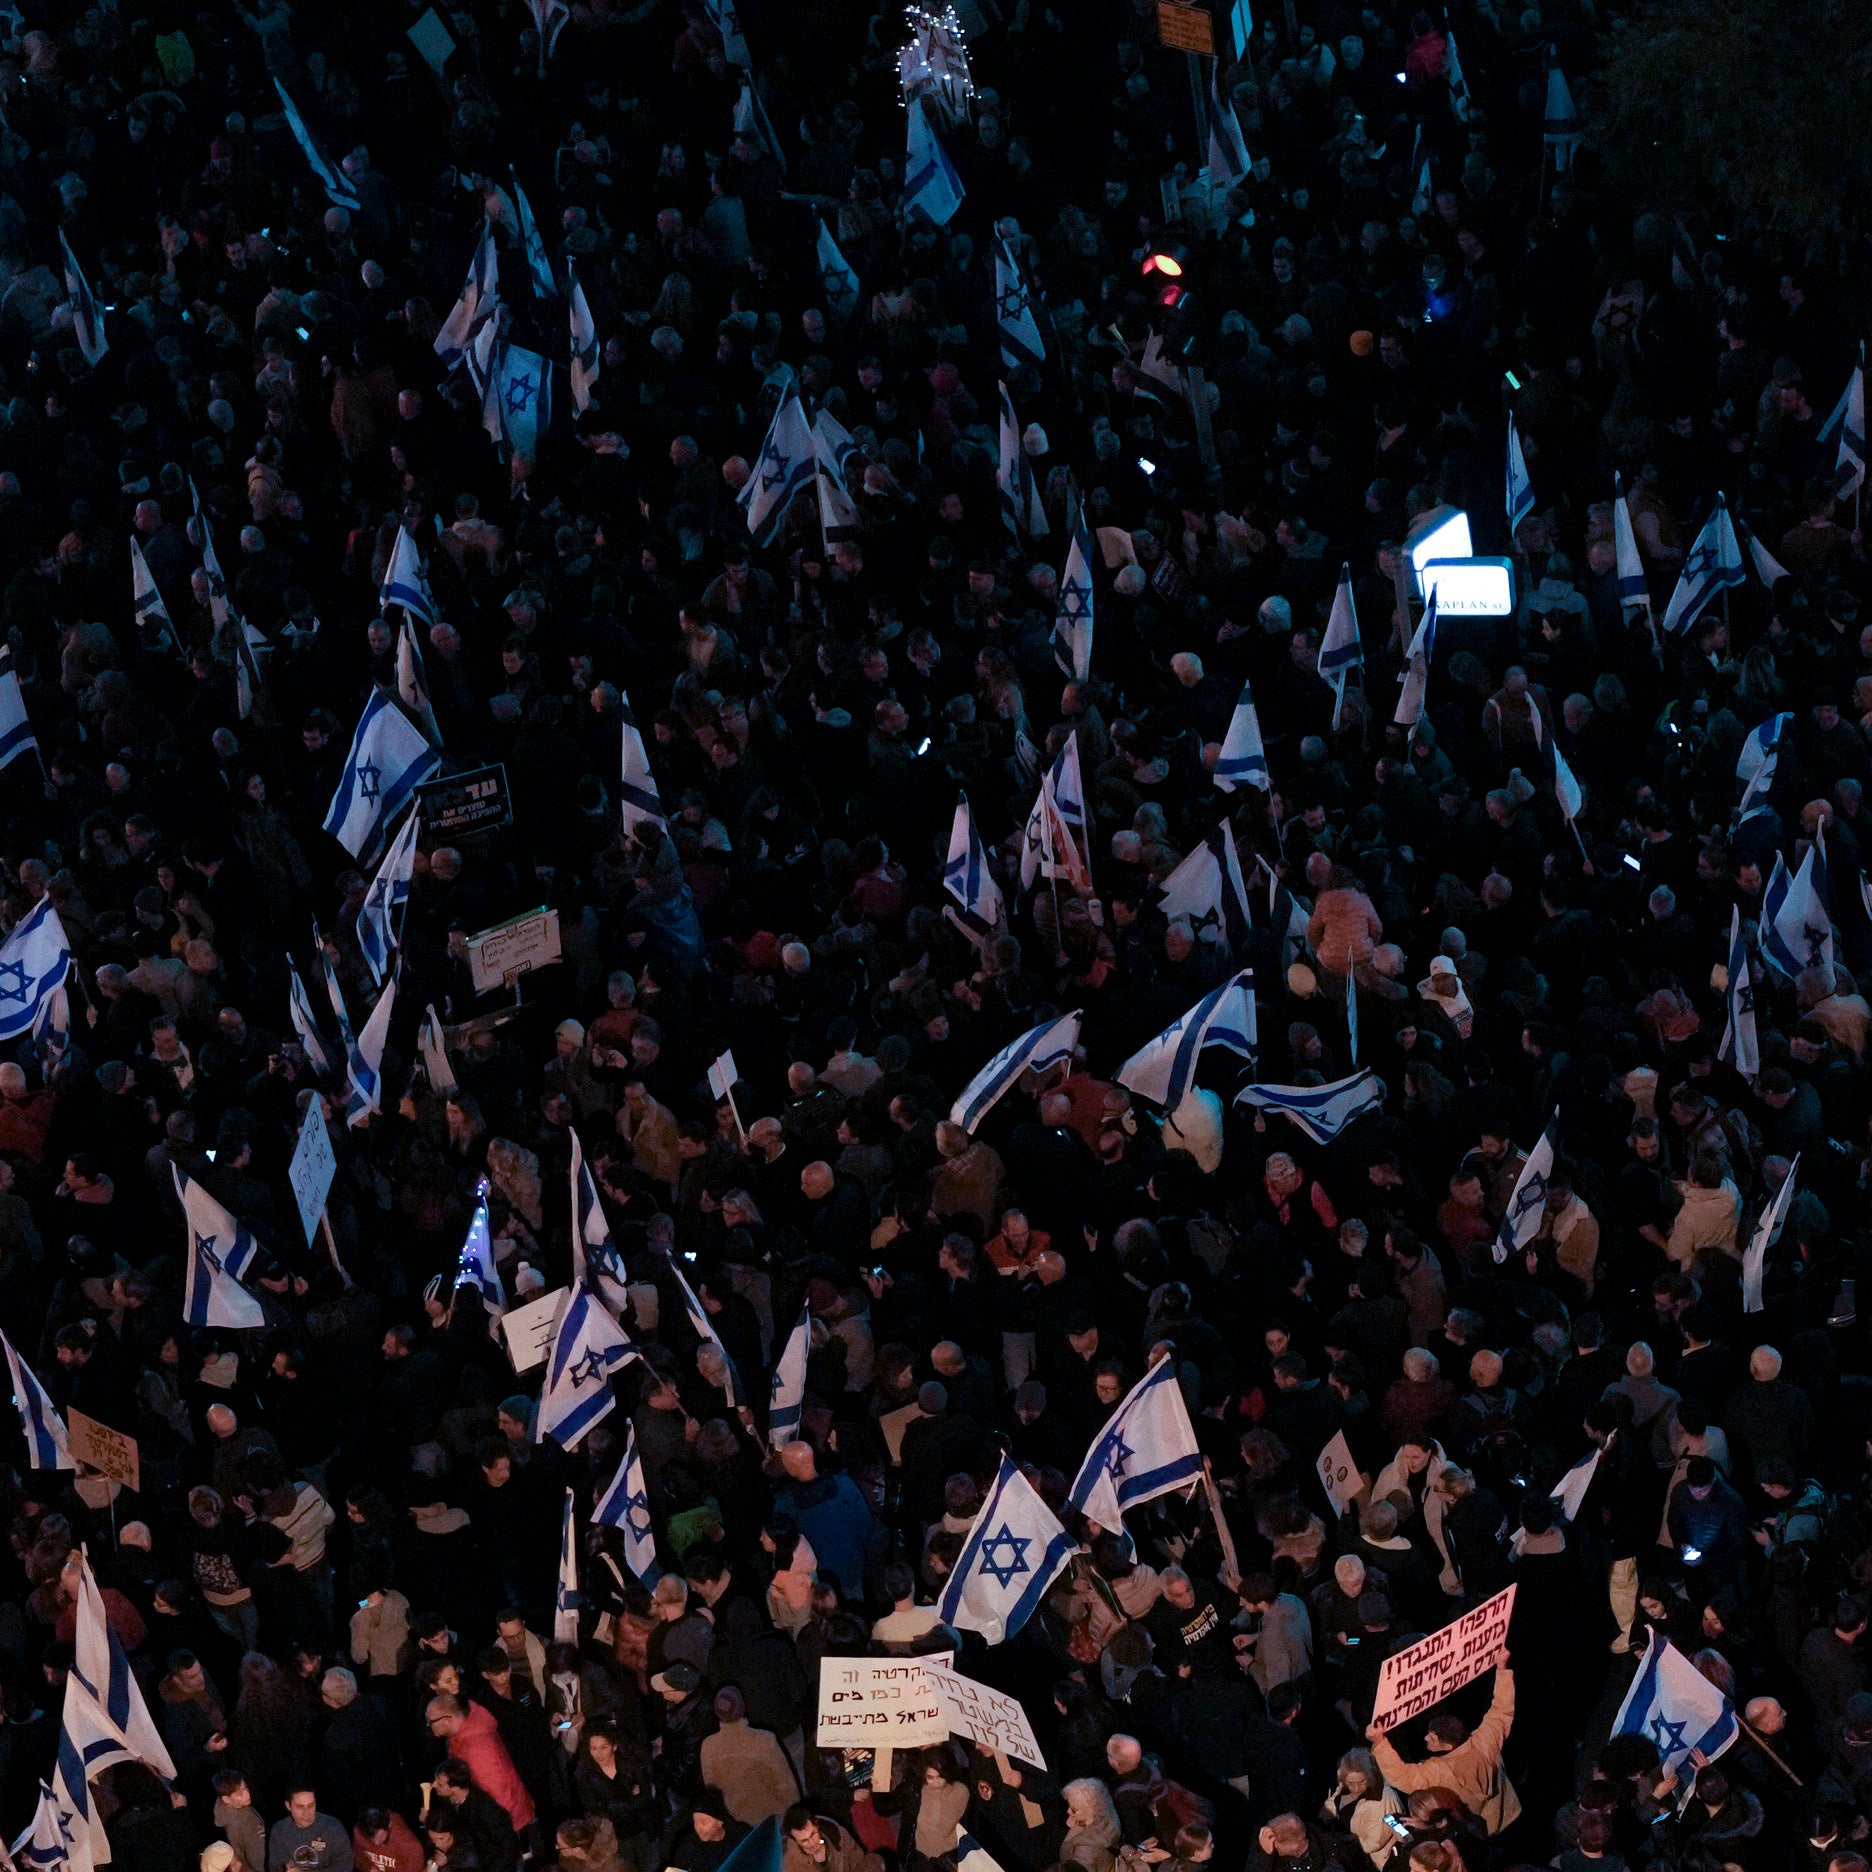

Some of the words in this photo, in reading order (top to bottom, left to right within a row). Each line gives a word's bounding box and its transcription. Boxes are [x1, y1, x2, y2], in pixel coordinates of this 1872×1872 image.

[1436, 600, 1488, 609] KAPLAN
[1387, 1629, 1452, 1680] התנגדו!
[842, 1670, 859, 1684] זה
[1394, 1650, 1456, 1701] שחיתות
[1440, 1665, 1470, 1697] העם
[832, 1690, 863, 1703] מים
[870, 1687, 901, 1700] כמו
[896, 1707, 939, 1724] שראל
[947, 1695, 1030, 1742] במשטר
[988, 1697, 1018, 1720] לא
[819, 1712, 889, 1726] מתייבשת
[1007, 1735, 1036, 1762] של
